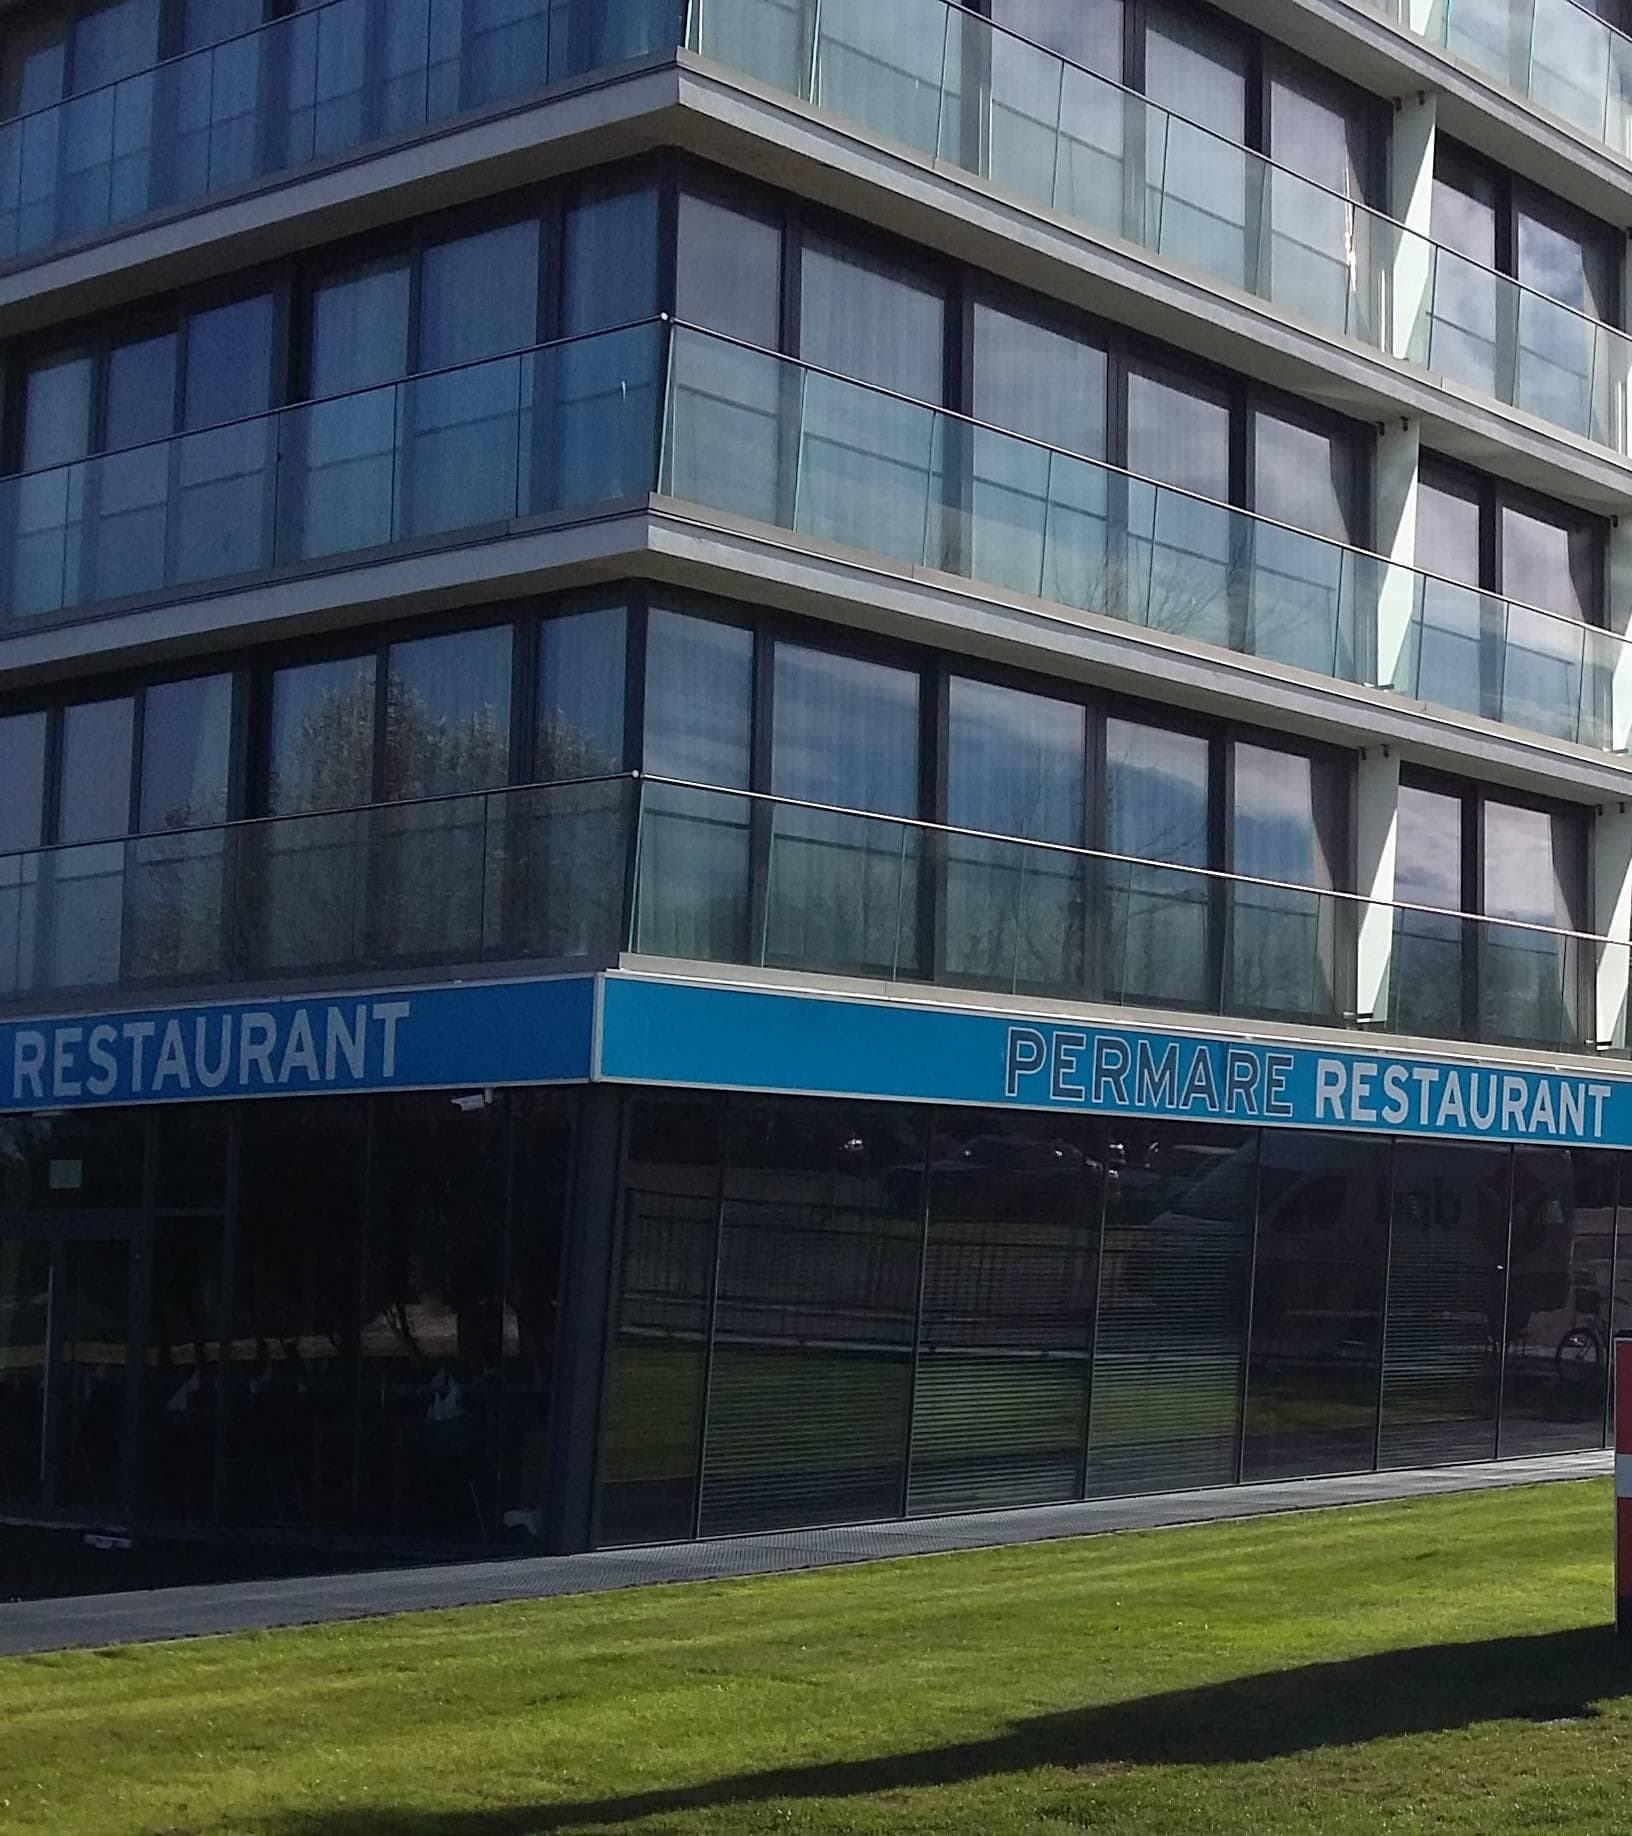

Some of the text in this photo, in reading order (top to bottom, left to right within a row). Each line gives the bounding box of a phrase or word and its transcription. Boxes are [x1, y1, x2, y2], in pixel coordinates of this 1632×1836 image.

[12, 1000, 411, 1099] RESTAURANT
[1005, 1026, 1612, 1138] PERMARE RESTAURANT
